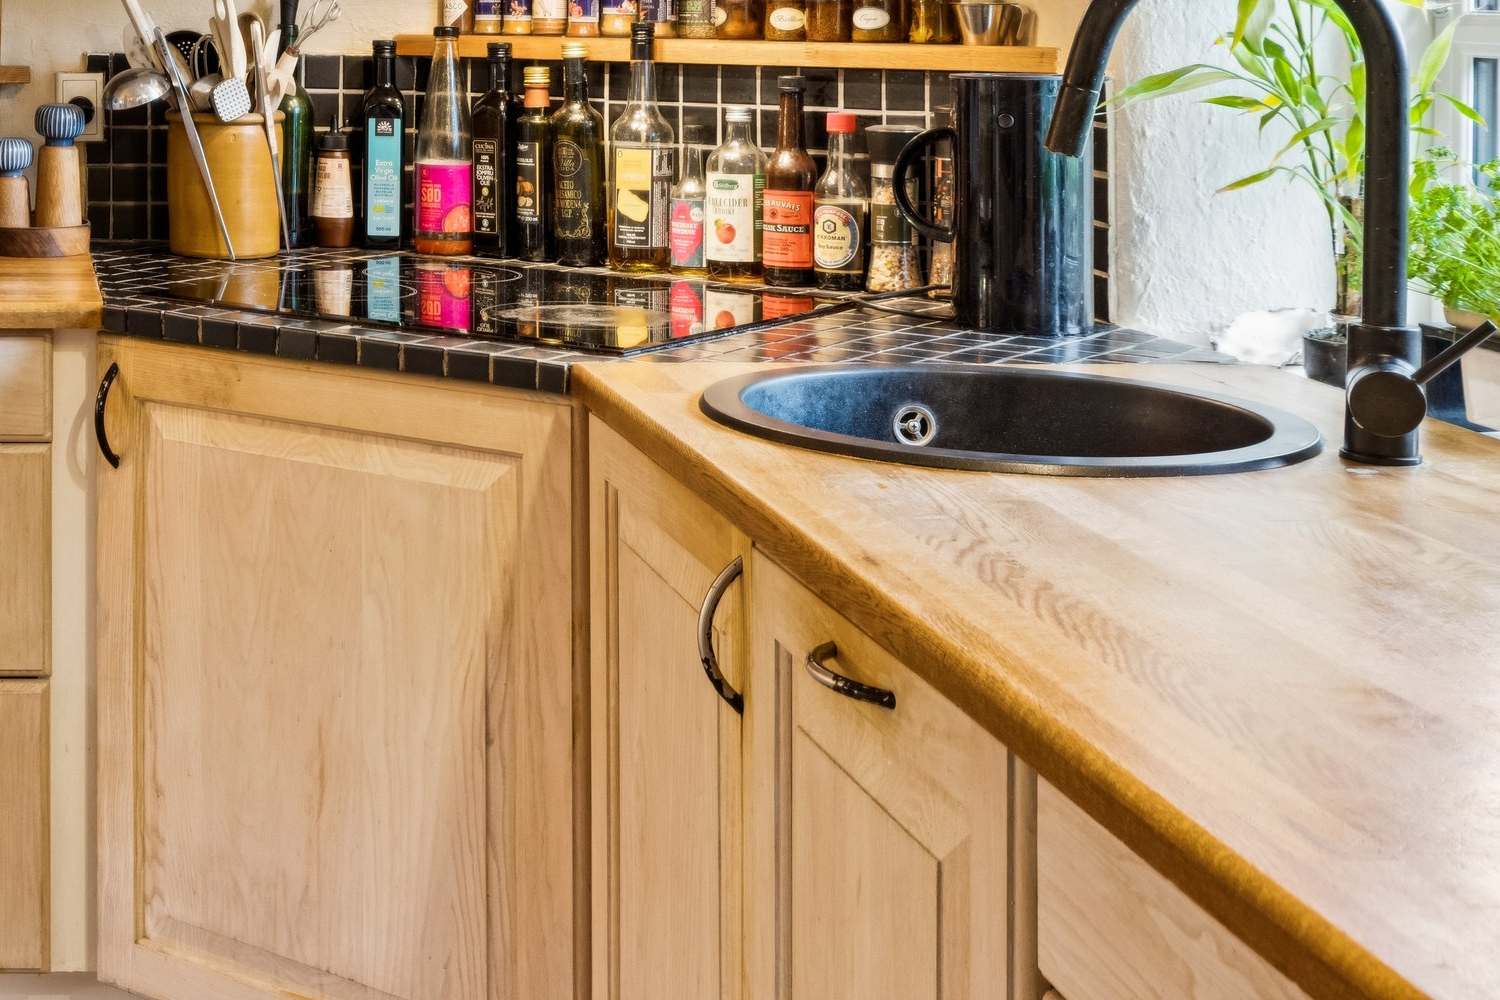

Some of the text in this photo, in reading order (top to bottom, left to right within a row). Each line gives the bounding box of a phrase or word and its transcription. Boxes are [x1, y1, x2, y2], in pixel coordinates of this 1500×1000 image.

[375, 166, 394, 175] Virgin
[422, 188, 441, 202] SØD
[776, 225, 804, 233] SAUCE
